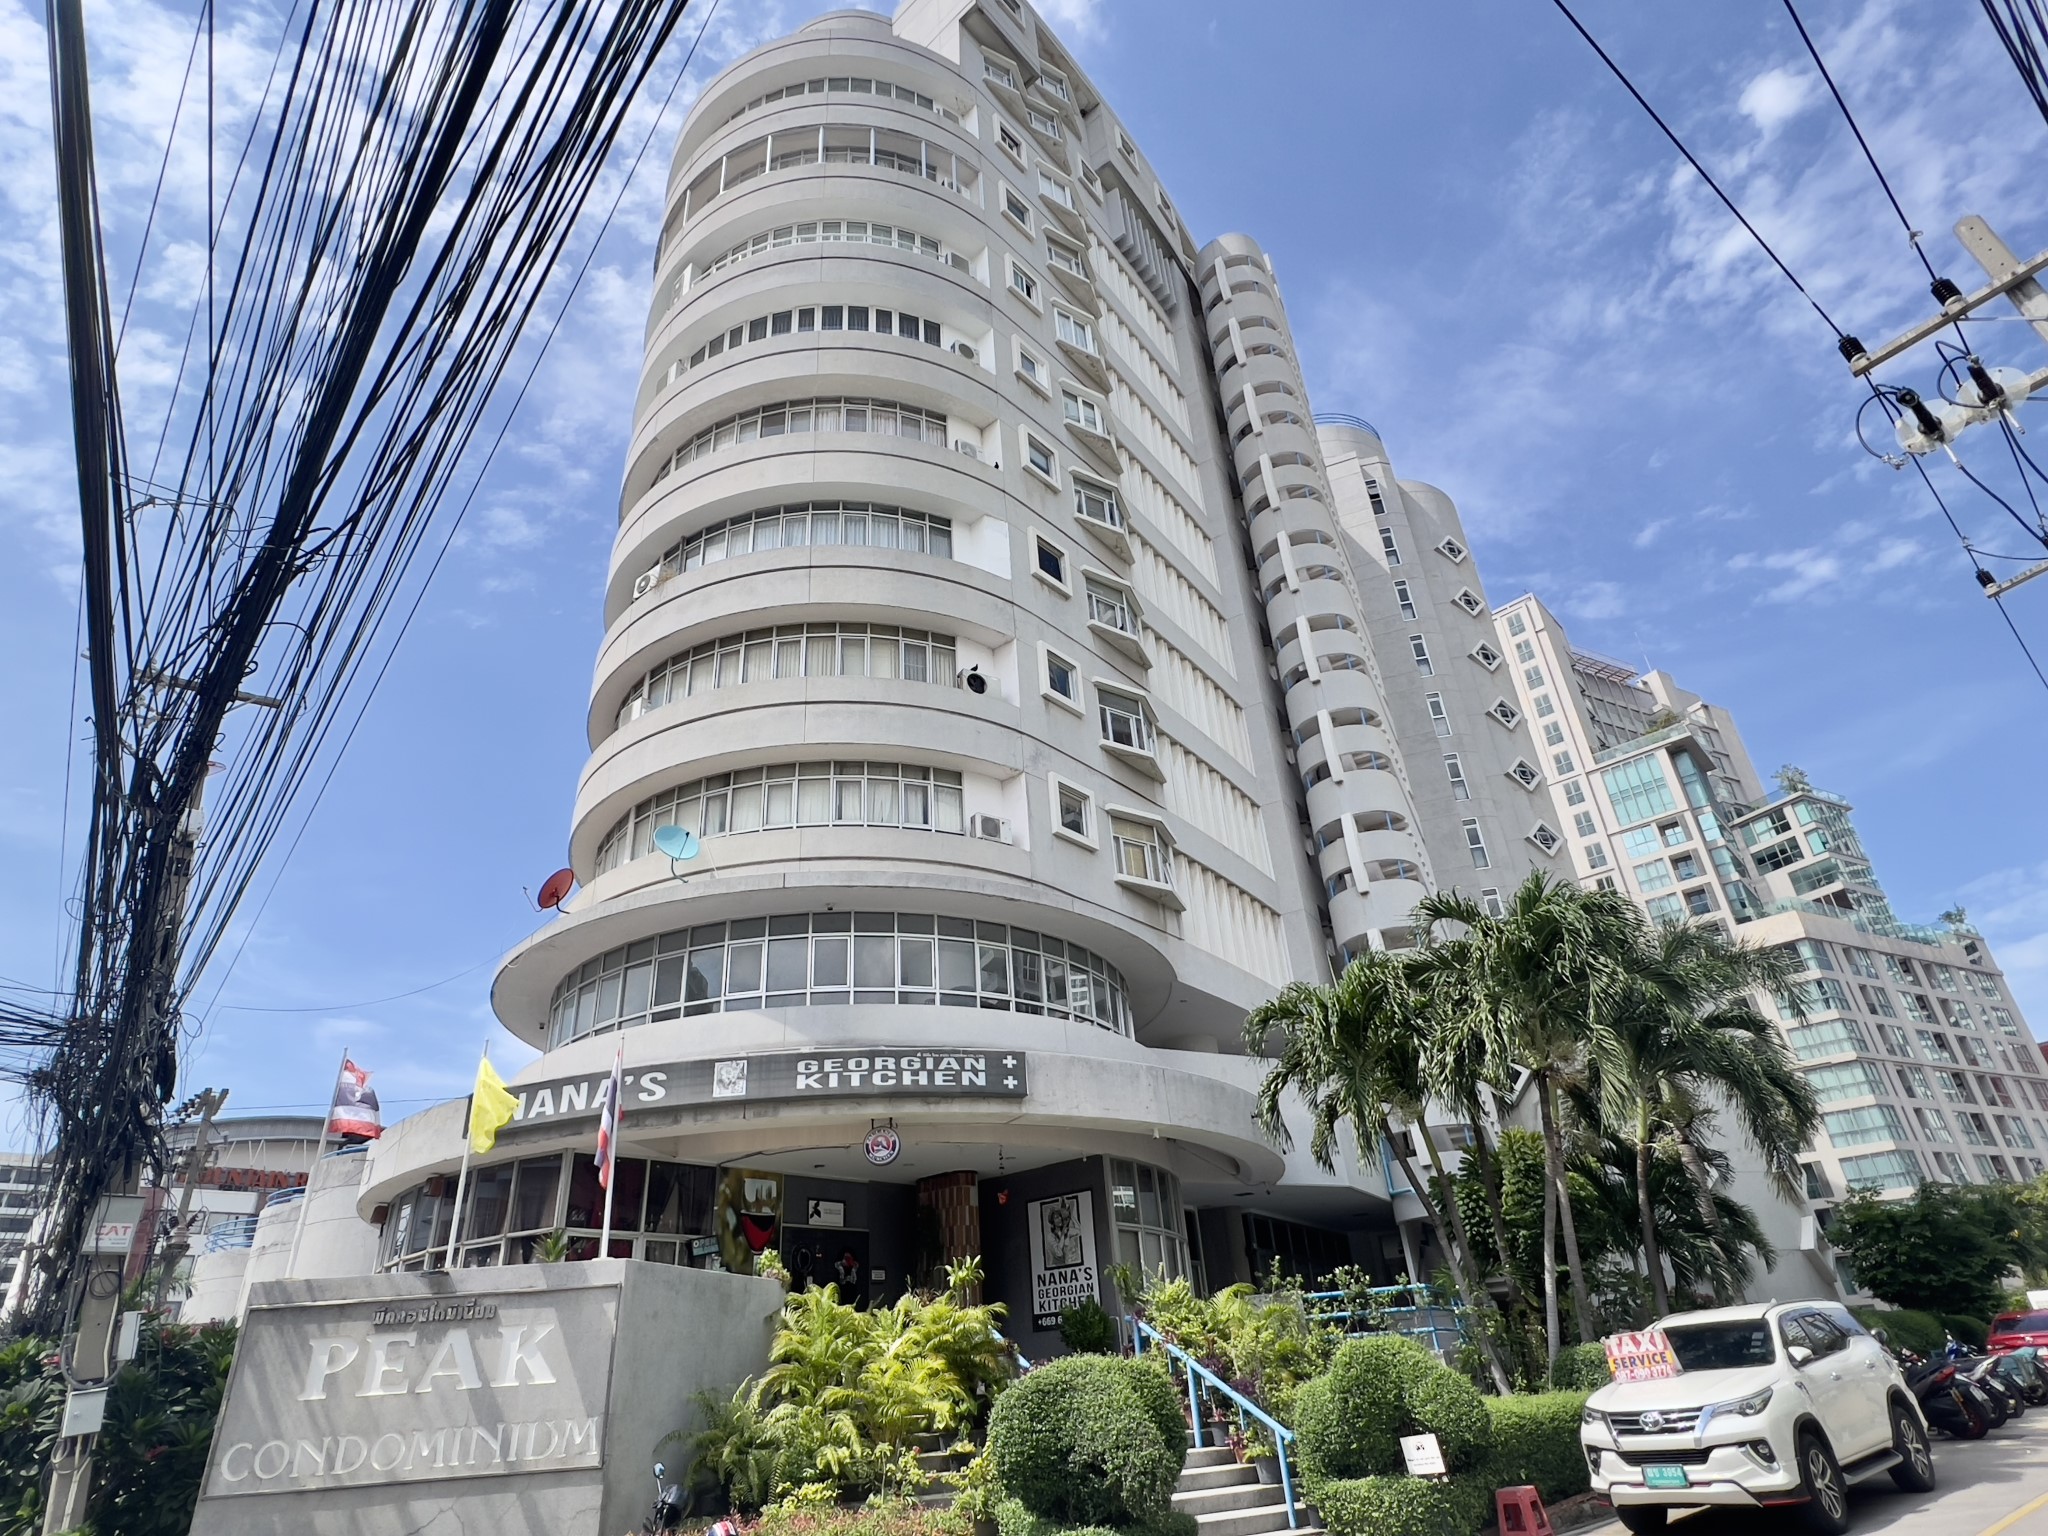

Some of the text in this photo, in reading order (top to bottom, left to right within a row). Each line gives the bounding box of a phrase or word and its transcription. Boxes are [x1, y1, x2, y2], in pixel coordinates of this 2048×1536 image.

[797, 1057, 986, 1073] GEORGIAN
[796, 1071, 987, 1090] KITCHEN
[95, 1225, 131, 1236] CAT
[1037, 1267, 1093, 1288] NANA'S
[1038, 1282, 1094, 1300] GEORGIAN
[1039, 1295, 1085, 1313] KITCHE
[1604, 1331, 1665, 1357] TAXI
[297, 1321, 557, 1401] PEAK
[1613, 1351, 1668, 1370] SERVICE
